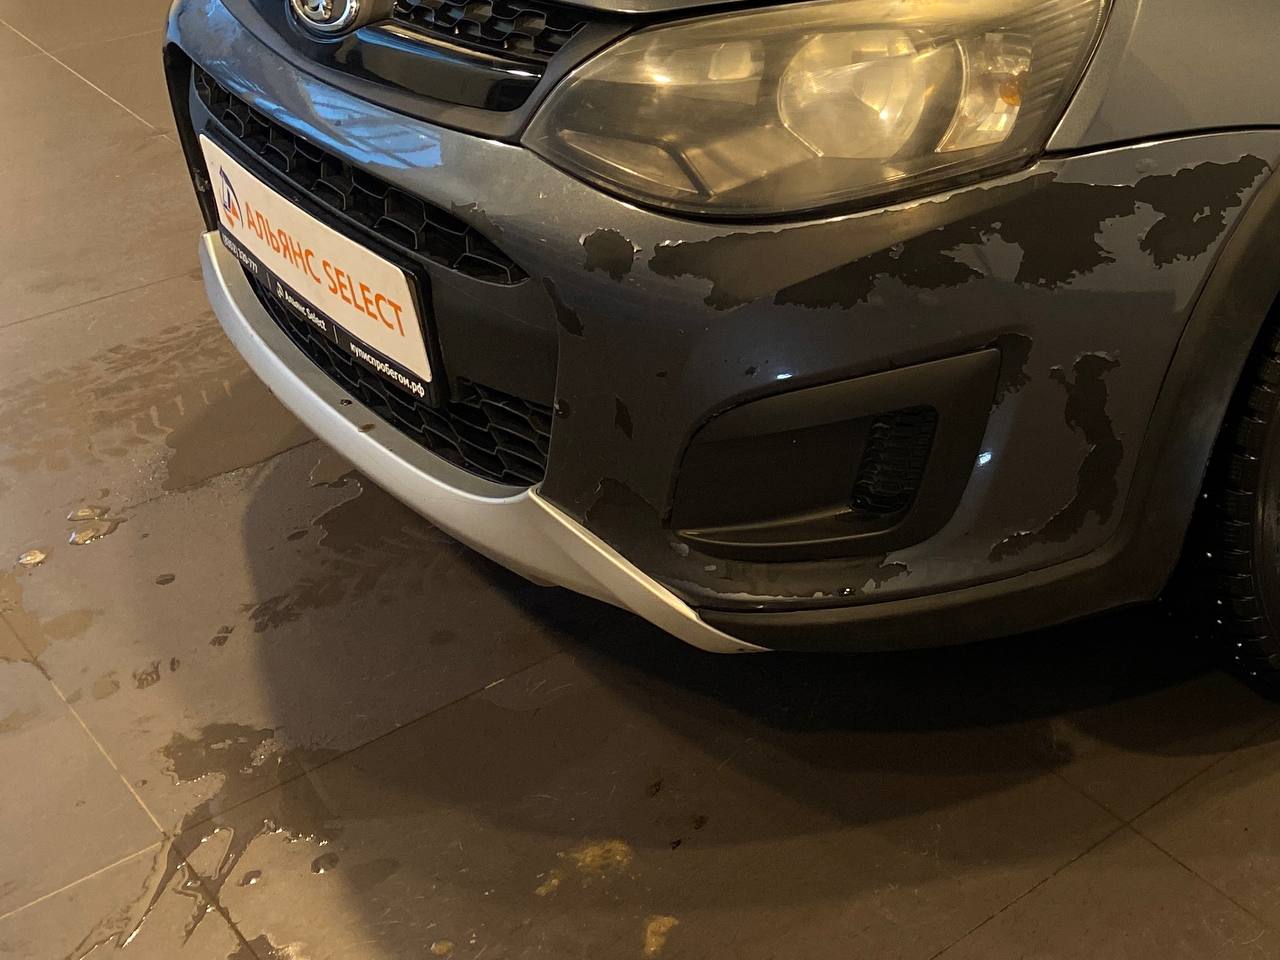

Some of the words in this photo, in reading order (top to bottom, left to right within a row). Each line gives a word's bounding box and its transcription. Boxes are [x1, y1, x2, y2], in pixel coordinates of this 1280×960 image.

[245, 201, 321, 285] АЛЬЯНС
[322, 259, 405, 337] SELECT
[350, 342, 425, 398] куписпробегом.рф
